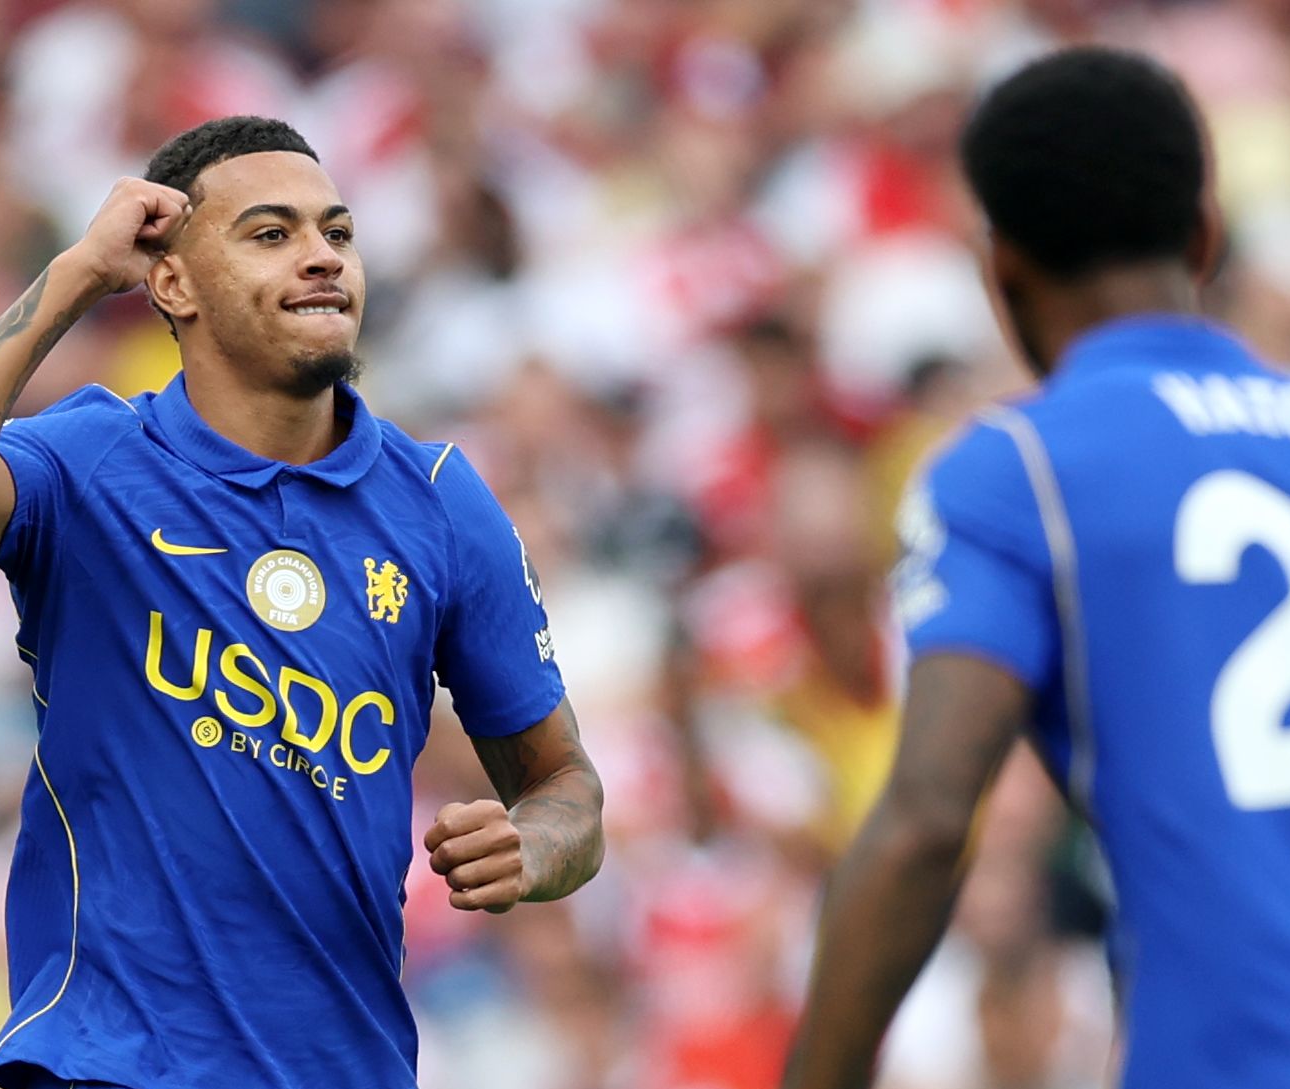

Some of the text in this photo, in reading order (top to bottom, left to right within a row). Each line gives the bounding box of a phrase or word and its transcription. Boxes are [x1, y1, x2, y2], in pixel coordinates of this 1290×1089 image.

[254, 557, 319, 606] WORLD CHAMPIONS
[269, 609, 299, 626] FIFA
[145, 611, 394, 774] USDC
[231, 731, 262, 759] BY
[270, 743, 347, 800] CIRCE
